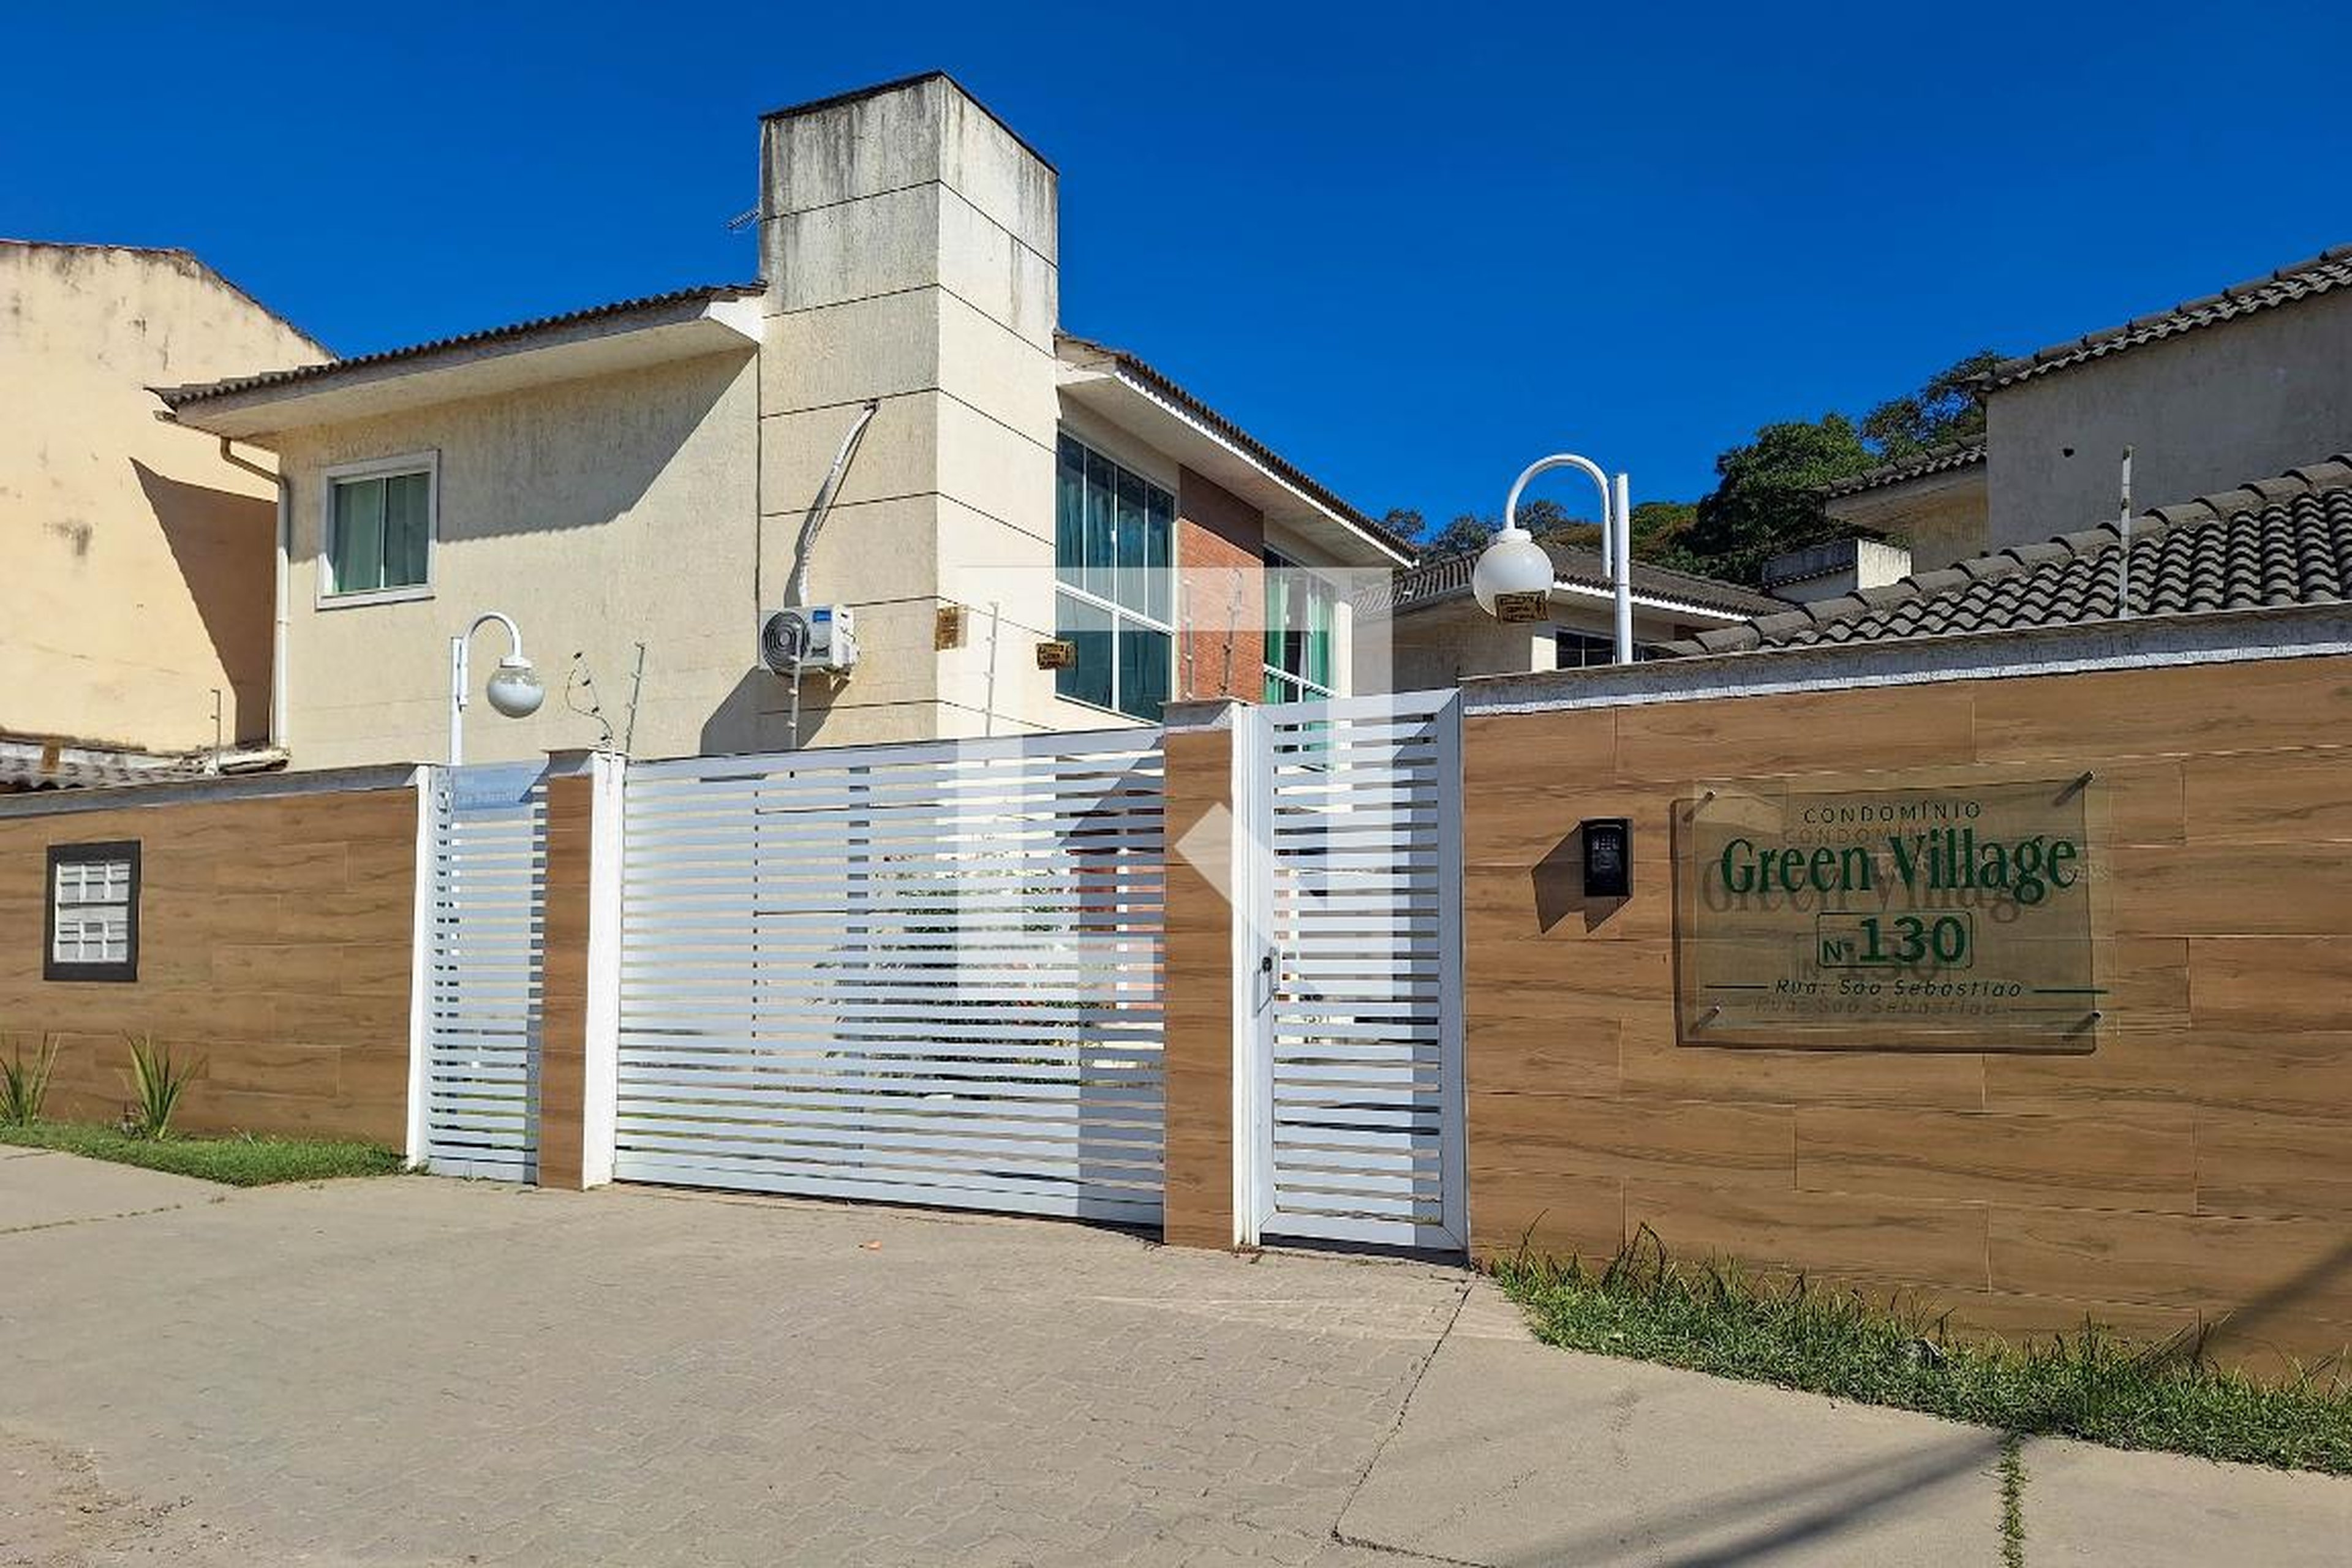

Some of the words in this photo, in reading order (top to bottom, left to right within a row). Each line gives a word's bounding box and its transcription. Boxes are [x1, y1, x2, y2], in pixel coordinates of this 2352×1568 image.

[1804, 800, 1981, 824] CONDOMÍNIO
[1721, 839, 1872, 892] Green
[1888, 829, 2078, 905] Village
[1860, 916, 1964, 962] 130
